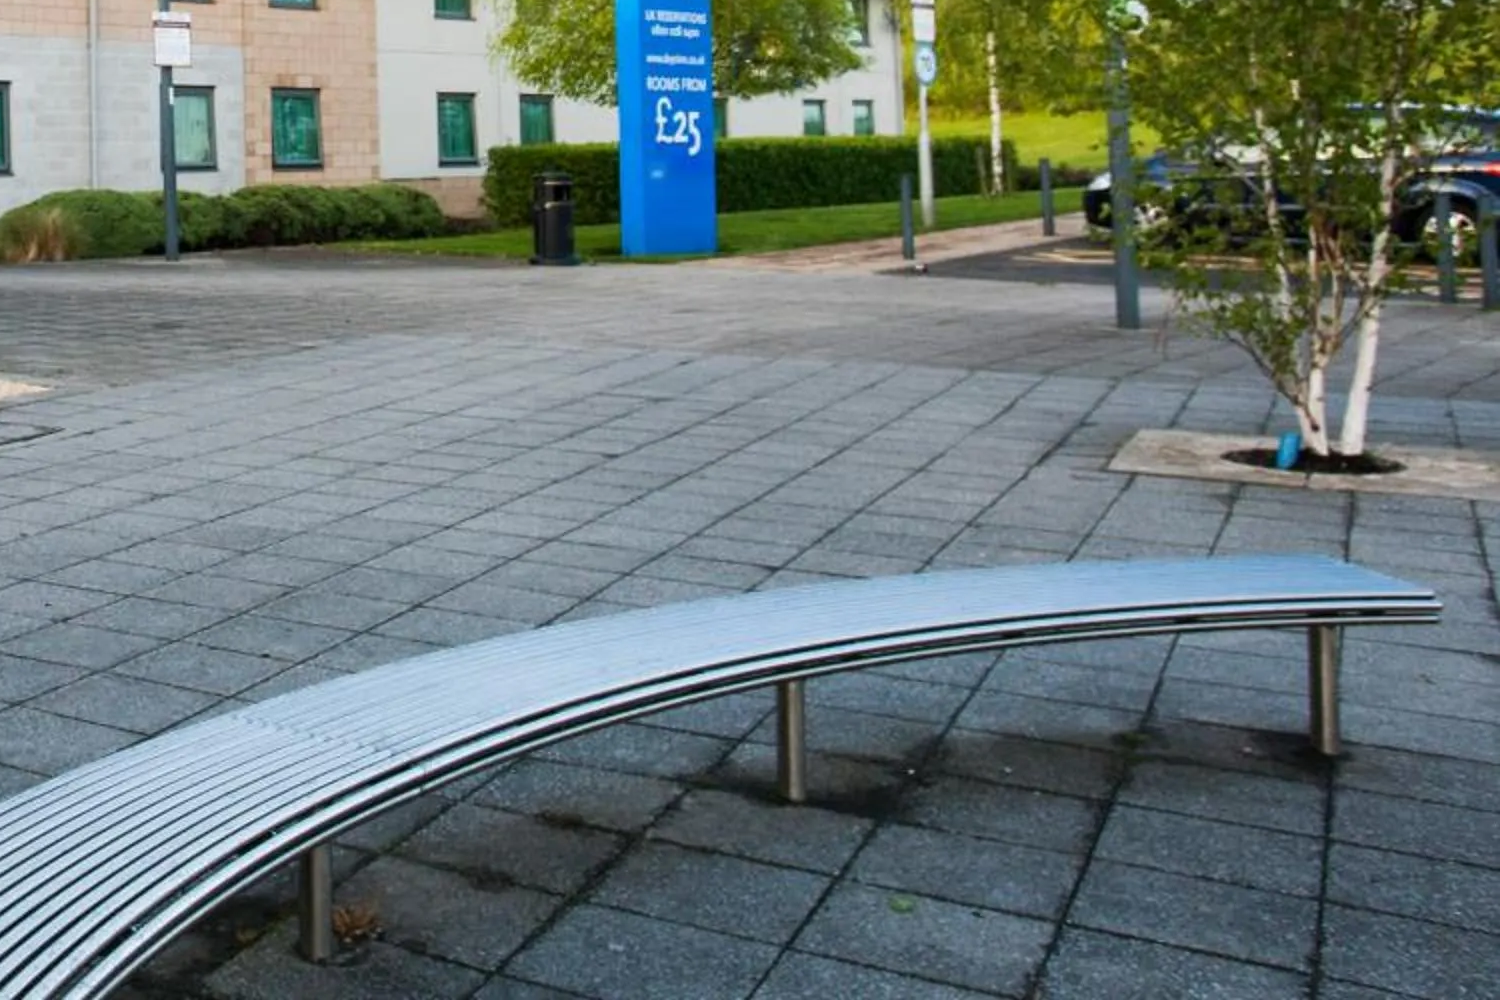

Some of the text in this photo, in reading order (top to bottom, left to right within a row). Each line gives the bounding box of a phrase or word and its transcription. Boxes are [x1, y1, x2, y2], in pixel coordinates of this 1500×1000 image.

[646, 76, 707, 93] ROOMS FROM
[656, 96, 701, 157] £25
